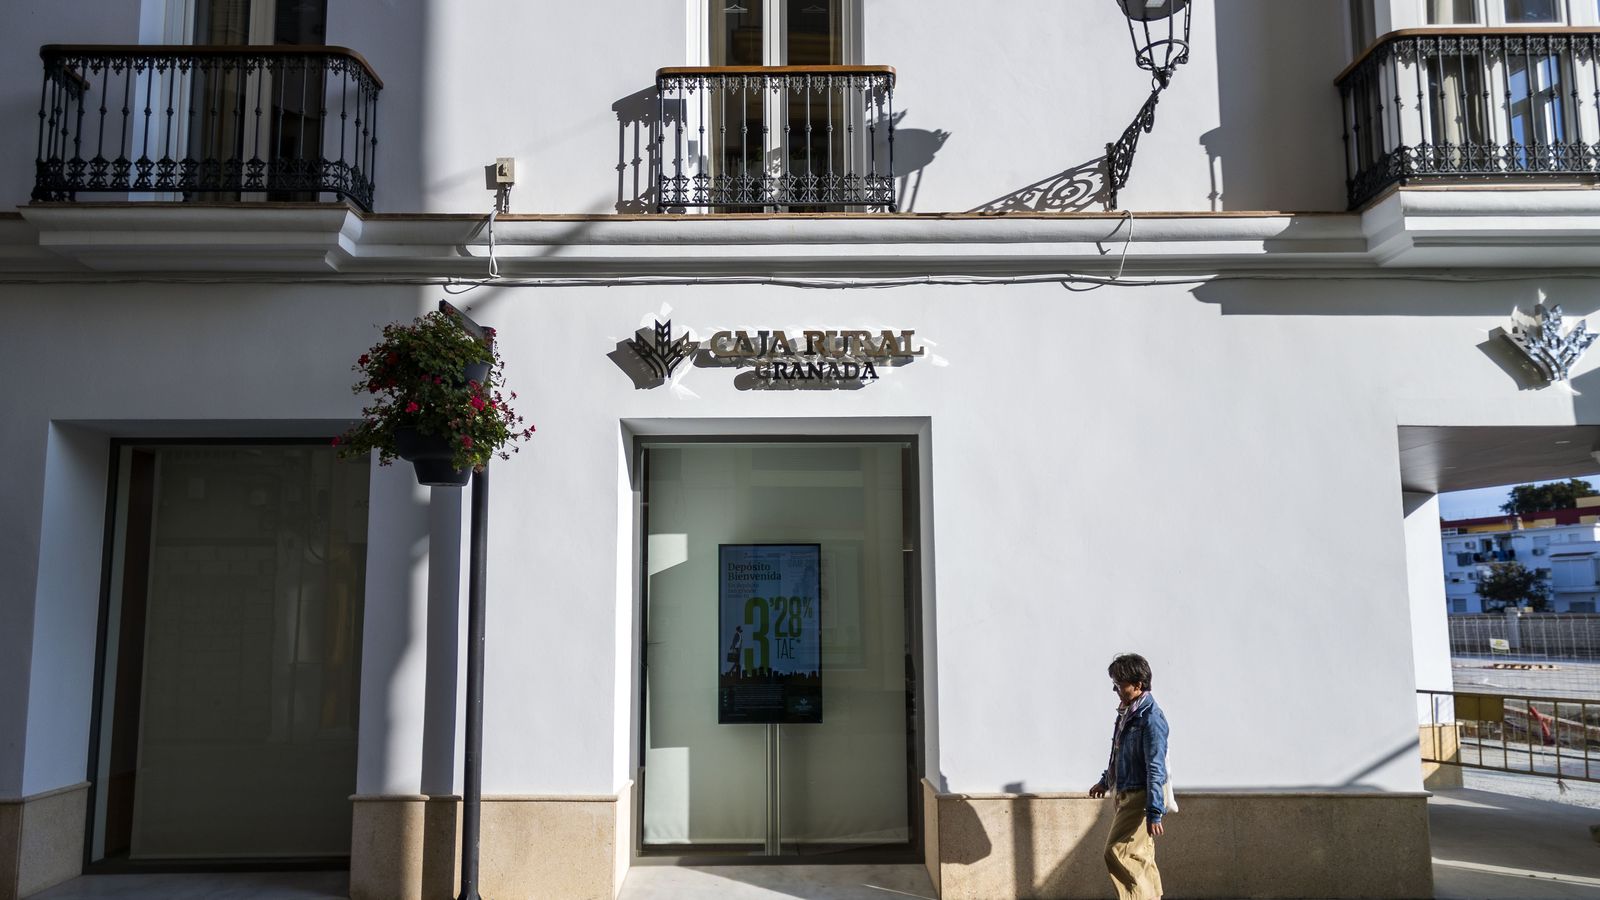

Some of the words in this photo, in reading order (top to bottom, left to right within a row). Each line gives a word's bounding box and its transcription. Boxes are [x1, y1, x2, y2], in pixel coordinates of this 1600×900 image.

[710, 330, 795, 357] CAJA
[803, 330, 924, 357] RURAL
[755, 361, 879, 380] GRANADA
[728, 561, 771, 573] Depósito
[728, 572, 782, 581] Bienvenida
